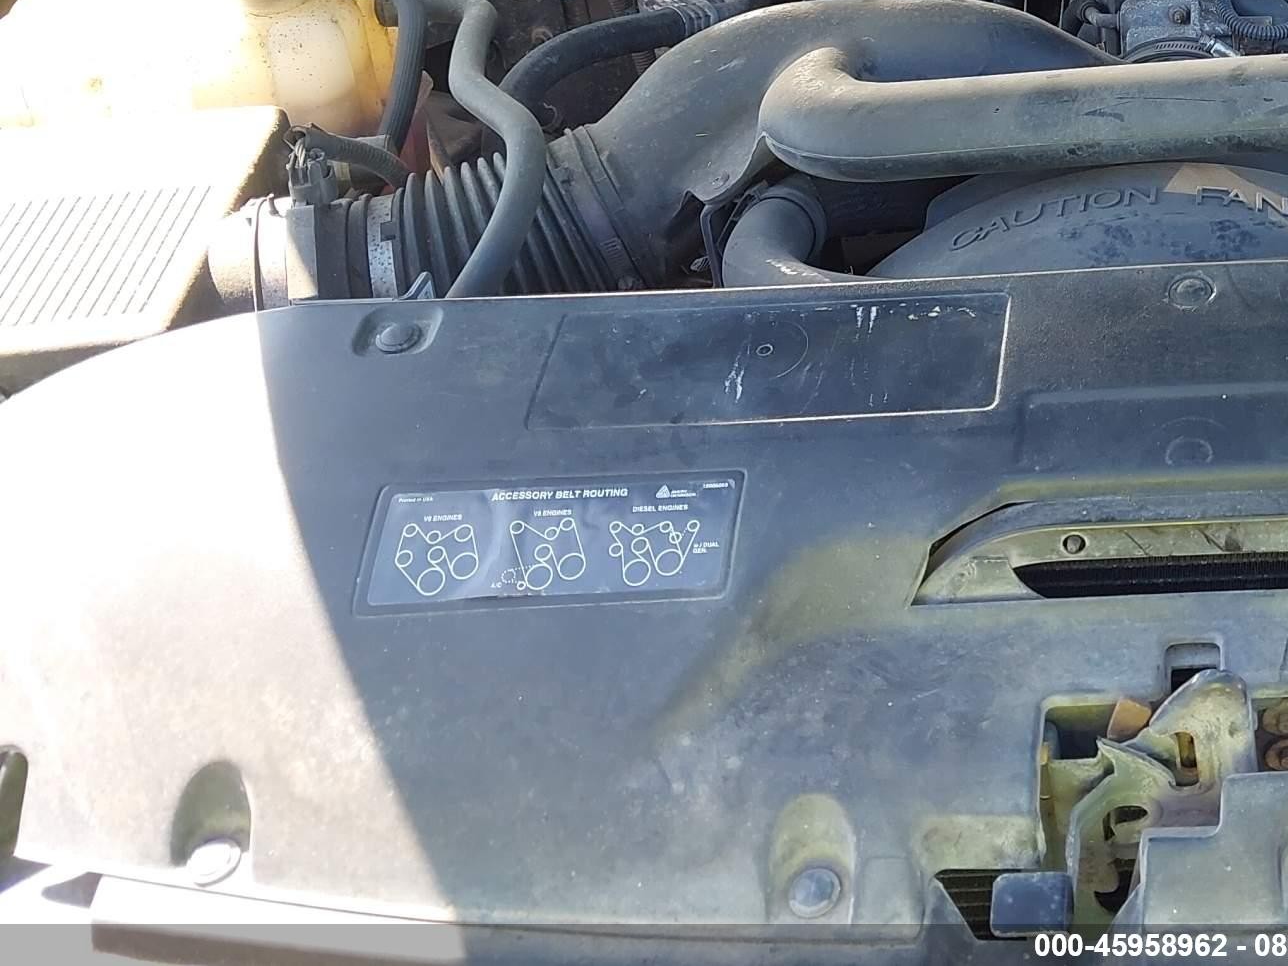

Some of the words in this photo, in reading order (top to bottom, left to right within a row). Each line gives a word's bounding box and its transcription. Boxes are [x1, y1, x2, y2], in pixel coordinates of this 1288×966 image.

[951, 185, 1160, 252] CAUTION
[1195, 185, 1288, 217] FAN
[491, 489, 554, 502] ACCESSORY
[555, 489, 582, 500] BELT
[583, 487, 629, 499] ROUTING
[542, 509, 573, 517] ENGINES
[632, 505, 657, 513] DIESEL
[658, 504, 689, 512] ENGINES
[432, 514, 463, 522] ENGINES
